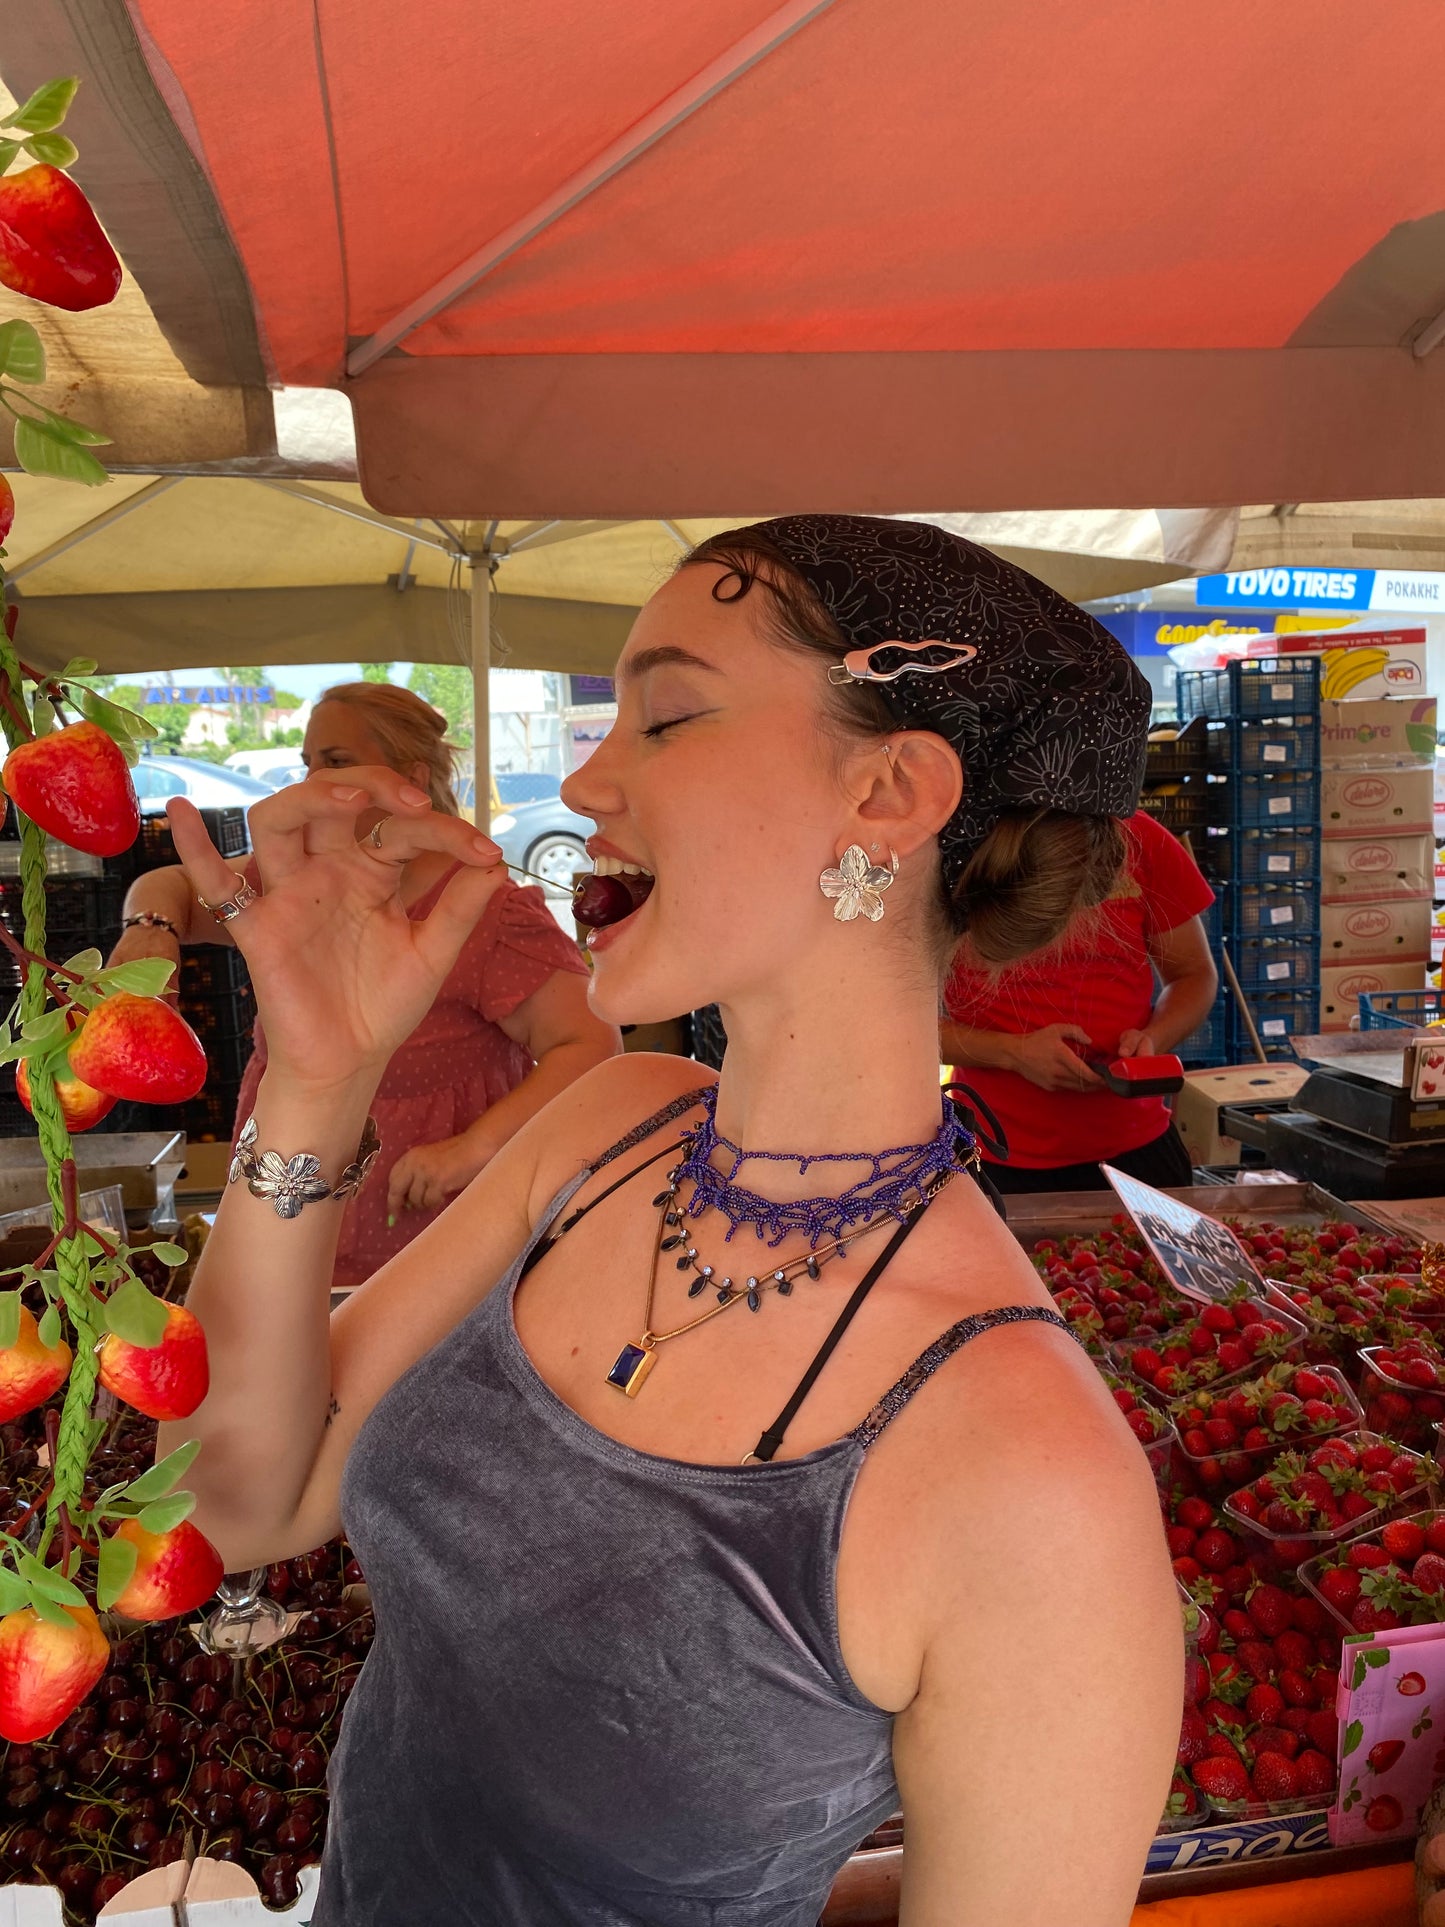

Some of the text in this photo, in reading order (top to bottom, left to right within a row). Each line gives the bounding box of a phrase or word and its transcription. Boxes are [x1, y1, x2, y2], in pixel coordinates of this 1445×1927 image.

[1225, 569, 1357, 600] TOYO TIRES
[1386, 580, 1440, 600] ΡΟΚΑΚΗΣ
[1388, 669, 1413, 681] Dole
[146, 686, 274, 704] ATLANTIS
